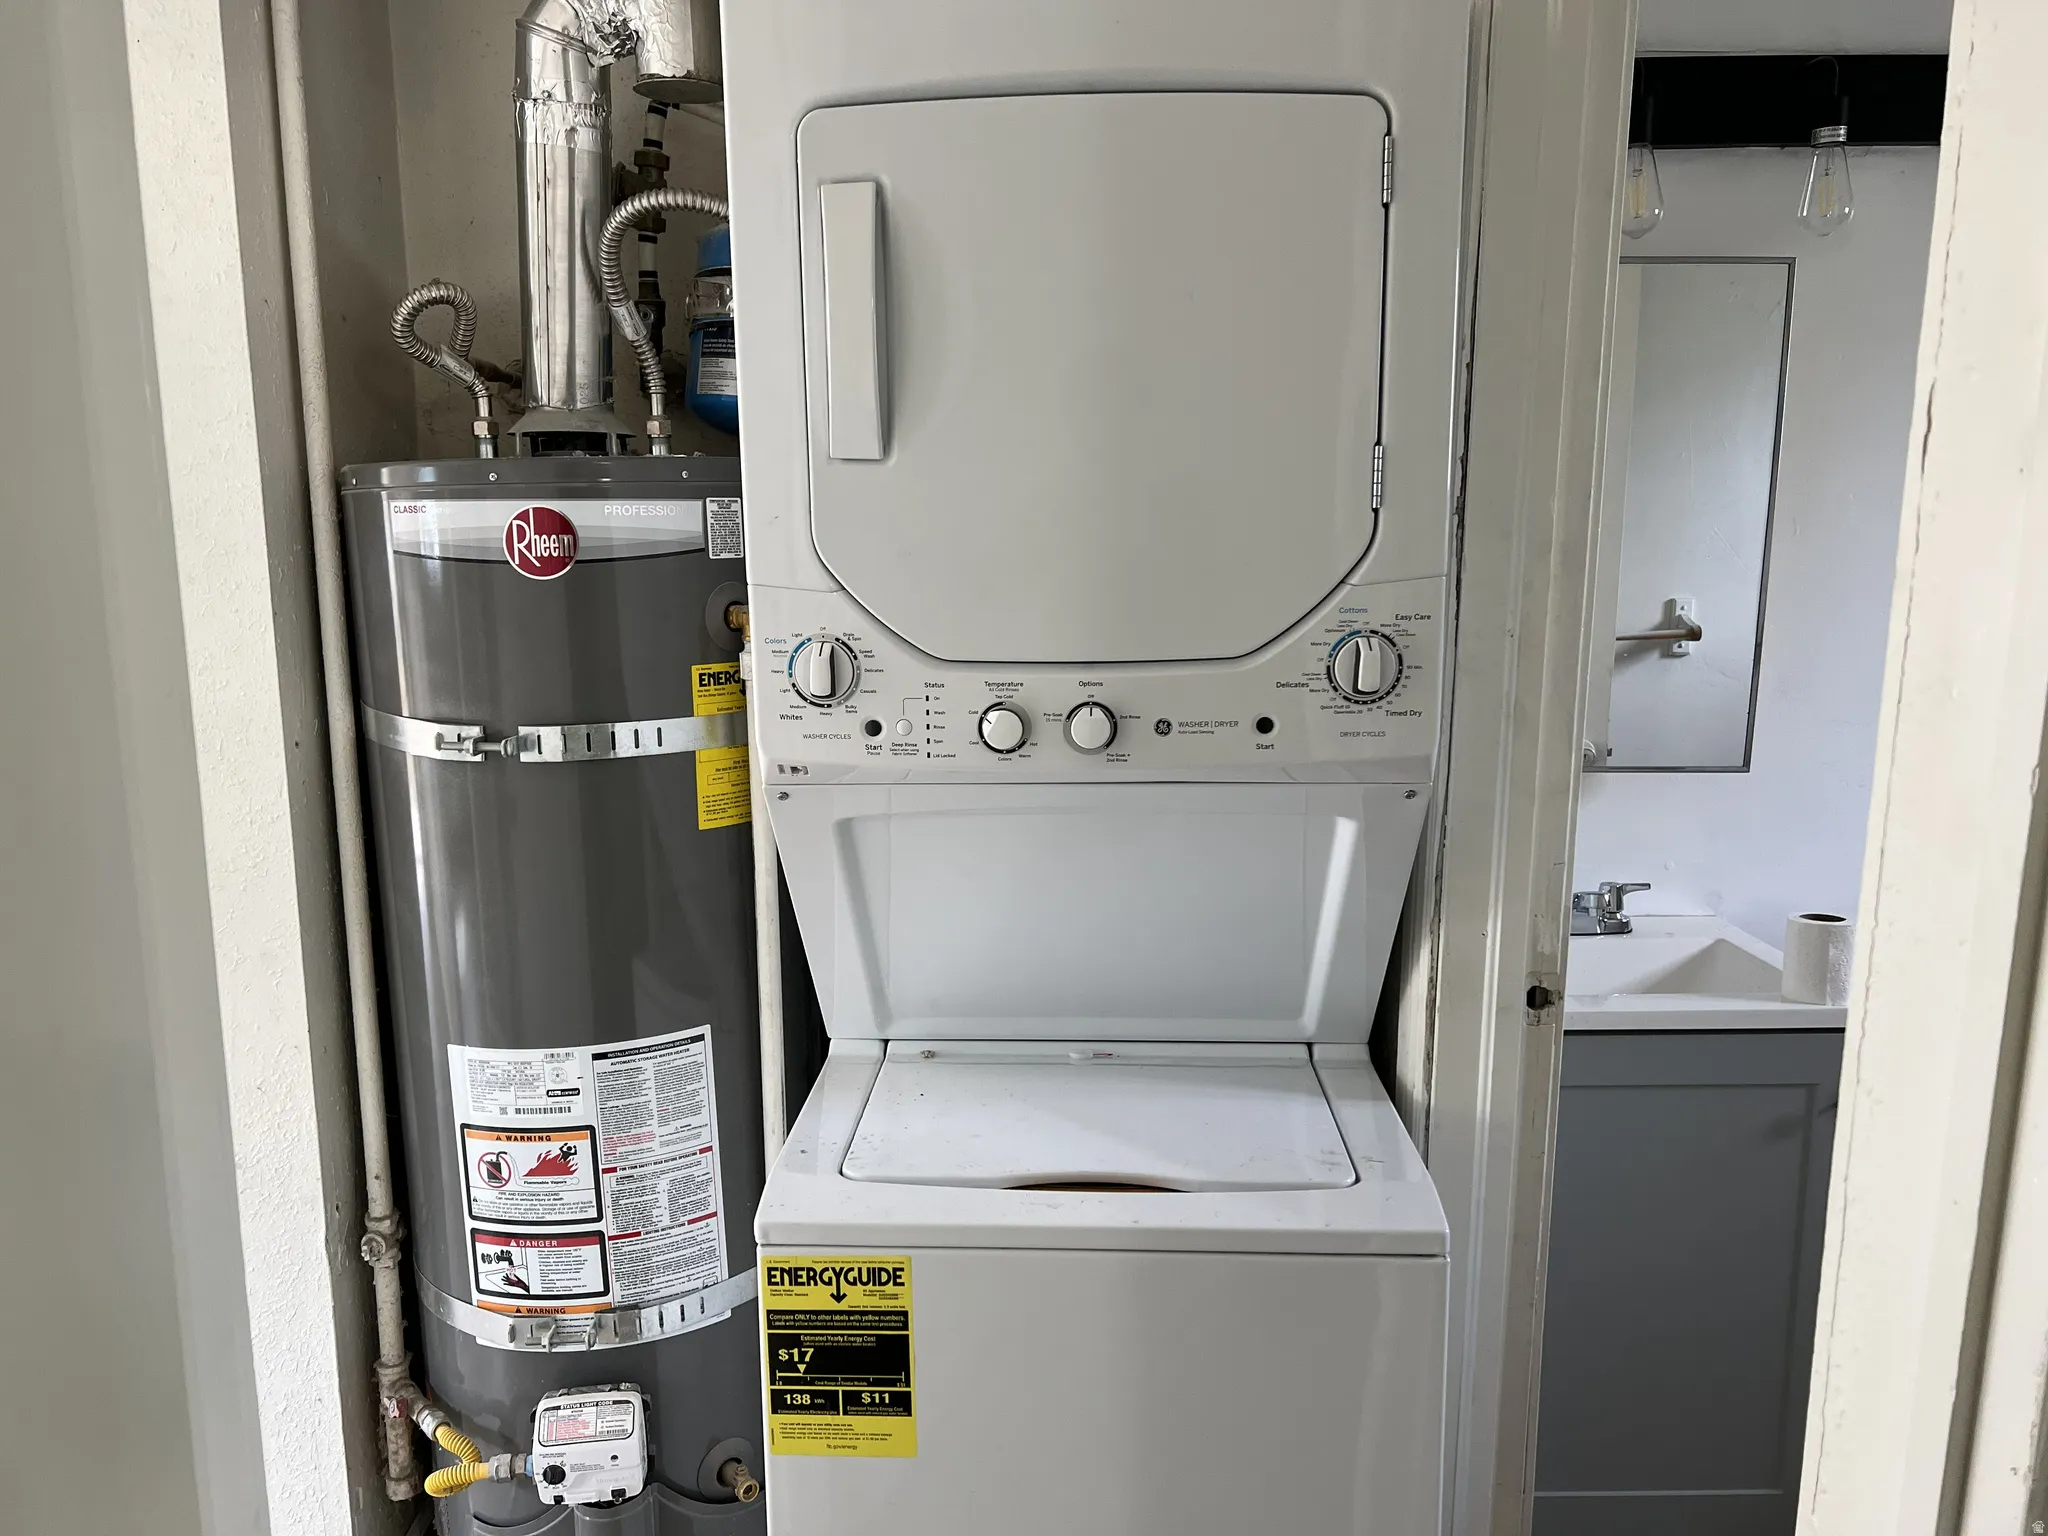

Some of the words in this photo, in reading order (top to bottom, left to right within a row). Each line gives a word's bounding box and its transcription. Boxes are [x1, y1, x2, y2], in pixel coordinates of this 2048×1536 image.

[393, 504, 427, 514] CLASSIC
[512, 508, 574, 567] Rheem
[1395, 614, 1412, 622] Easy
[1078, 680, 1103, 688] Options
[1409, 709, 1422, 717] Dry
[1177, 720, 1209, 728] WASHER
[607, 1047, 639, 1058] INSTALLATION
[649, 1042, 673, 1051] OPERATION
[674, 1038, 691, 1046] DETAILS
[610, 1058, 637, 1066] AUTOMATIC
[505, 1134, 552, 1142] WARNING
[678, 1151, 697, 1160] OPERATING
[660, 1222, 686, 1232] INSTRUCTIONS
[519, 1239, 558, 1247] DANGER
[767, 1267, 905, 1287] ENERGYGUIDE
[778, 1347, 814, 1362] $17
[783, 1393, 811, 1405] 138
[861, 1392, 890, 1404] $11
